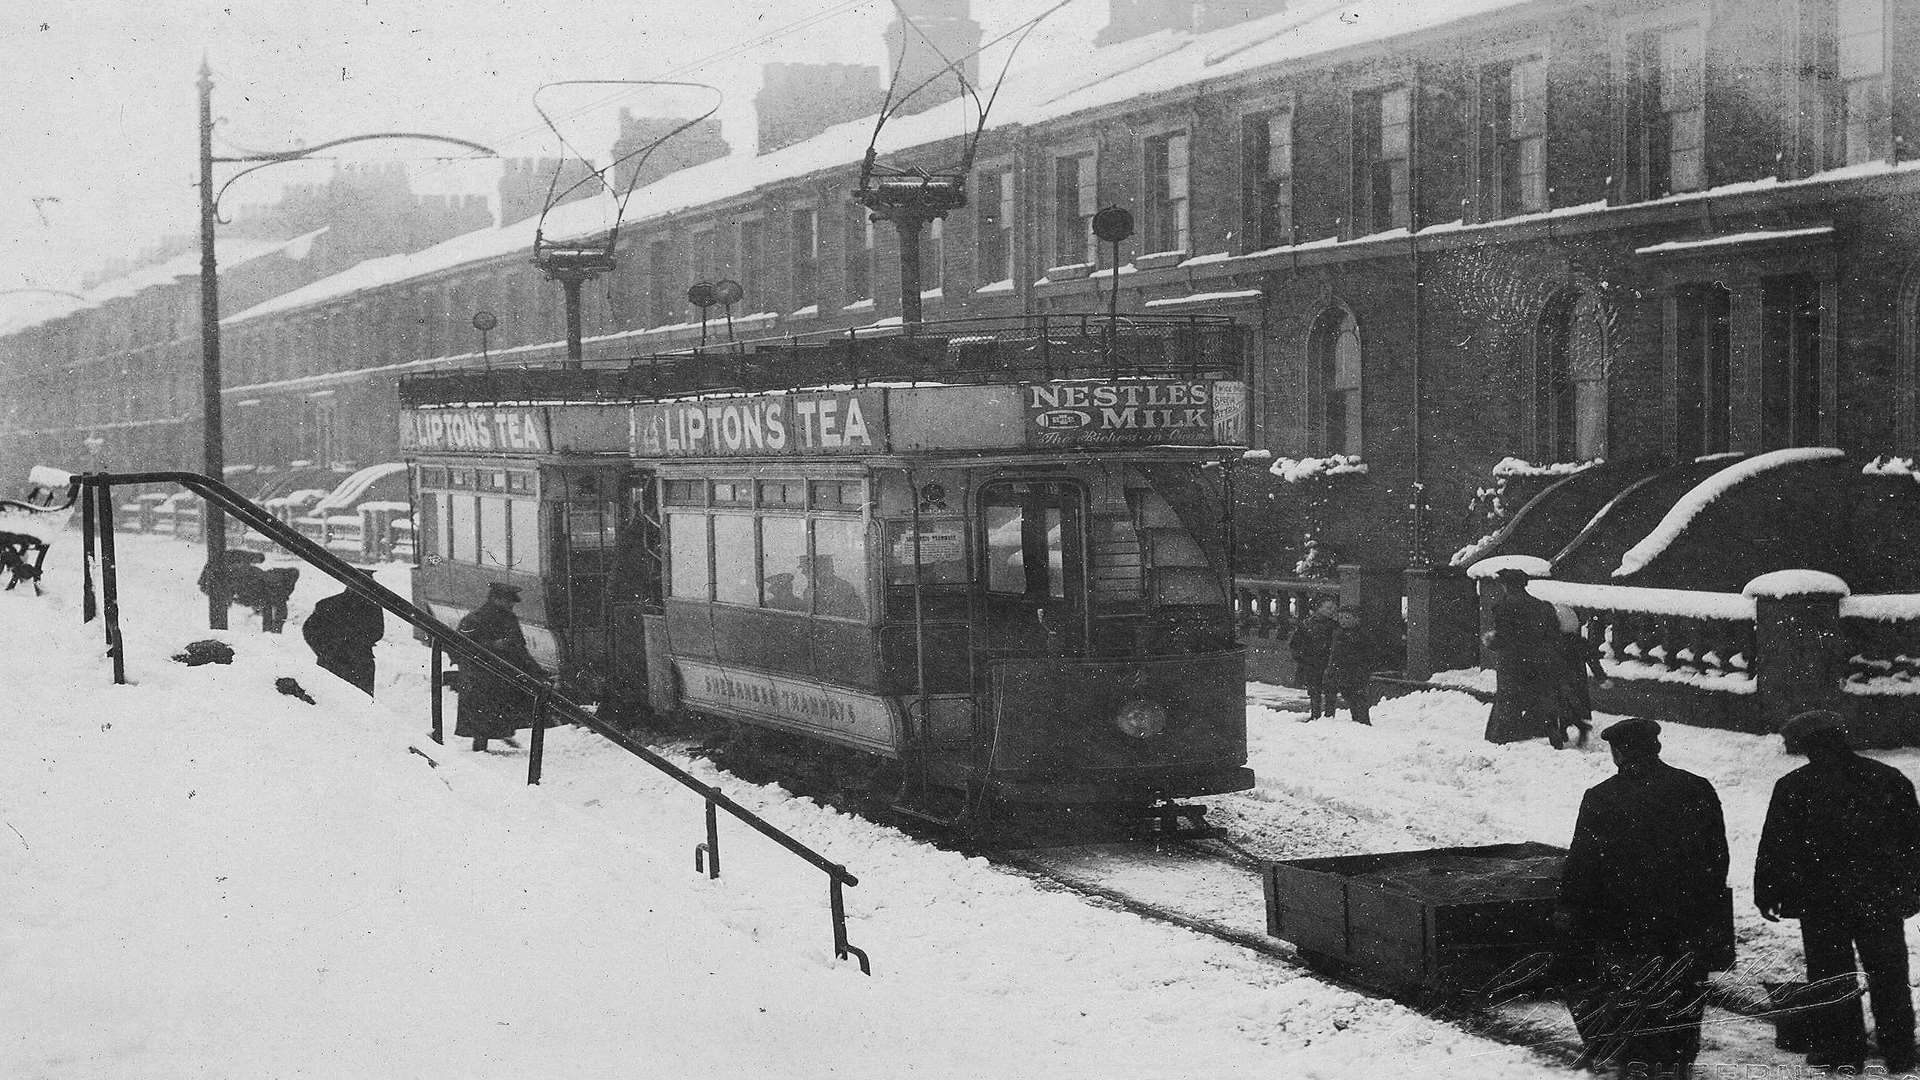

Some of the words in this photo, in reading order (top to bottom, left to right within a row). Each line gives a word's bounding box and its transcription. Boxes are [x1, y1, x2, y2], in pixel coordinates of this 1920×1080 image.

[494, 412, 541, 449] TEA
[664, 401, 786, 451] LIPTON'S
[798, 397, 872, 449] TEA
[1100, 407, 1208, 429] MILK
